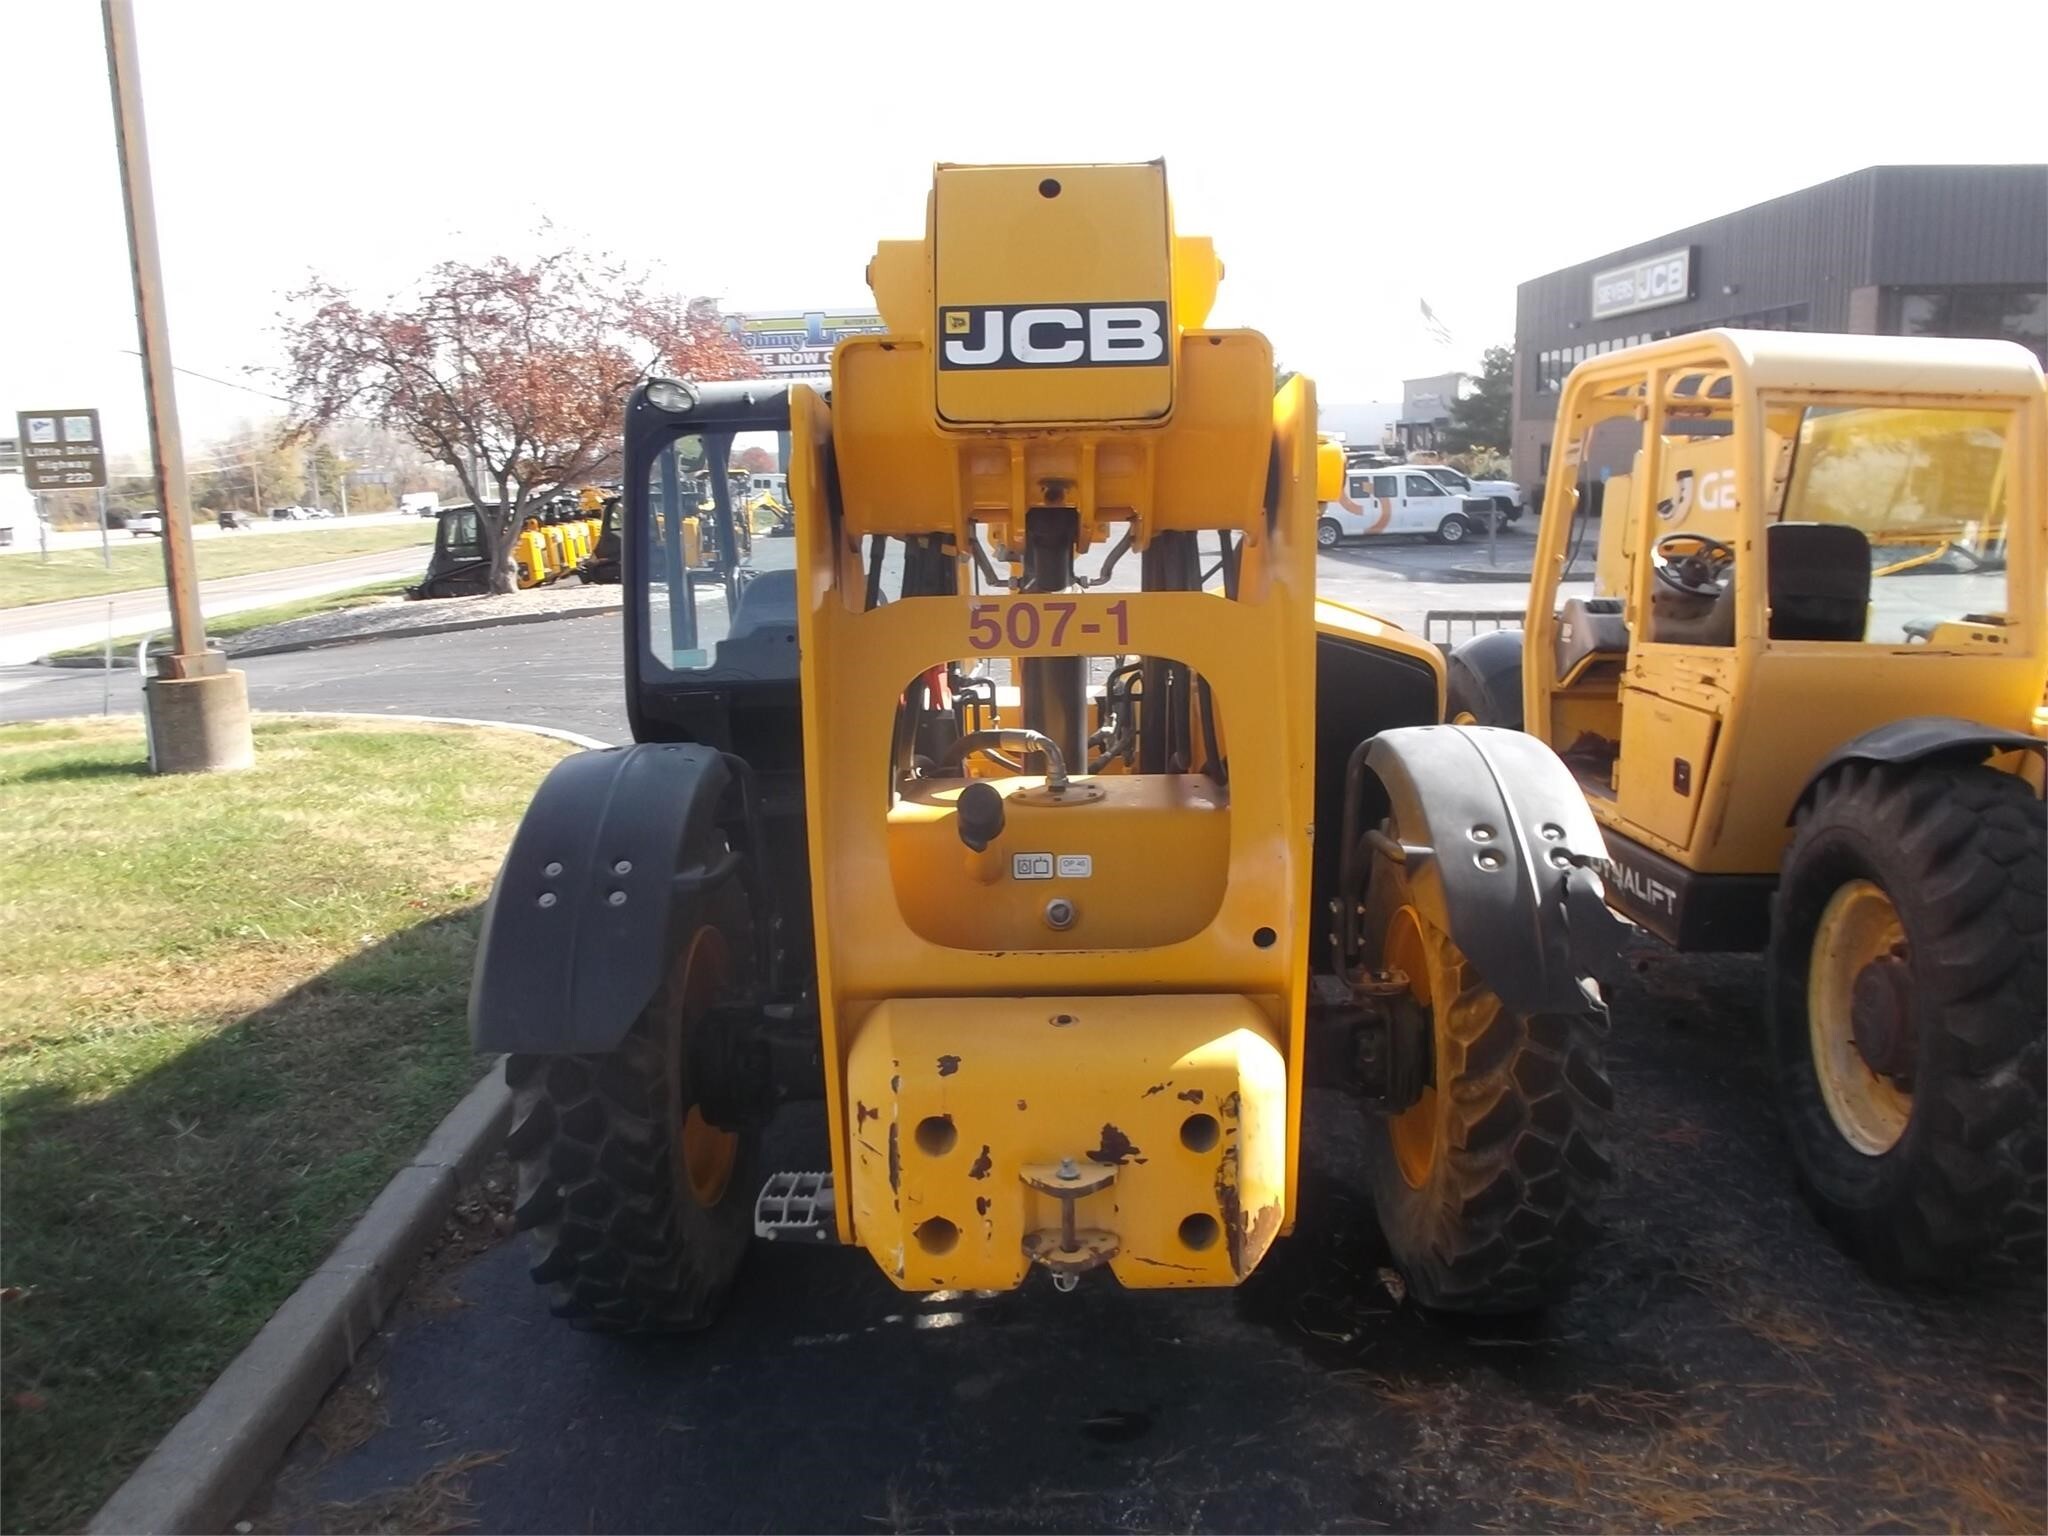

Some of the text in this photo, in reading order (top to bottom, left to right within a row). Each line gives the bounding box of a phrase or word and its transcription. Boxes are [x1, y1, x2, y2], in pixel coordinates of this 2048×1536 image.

[1638, 260, 1683, 300] JCB
[945, 307, 1163, 365] JCB
[779, 351, 820, 366] NOW
[36, 460, 92, 471] Highway
[65, 472, 93, 483] 220
[968, 600, 1129, 650] 507-1
